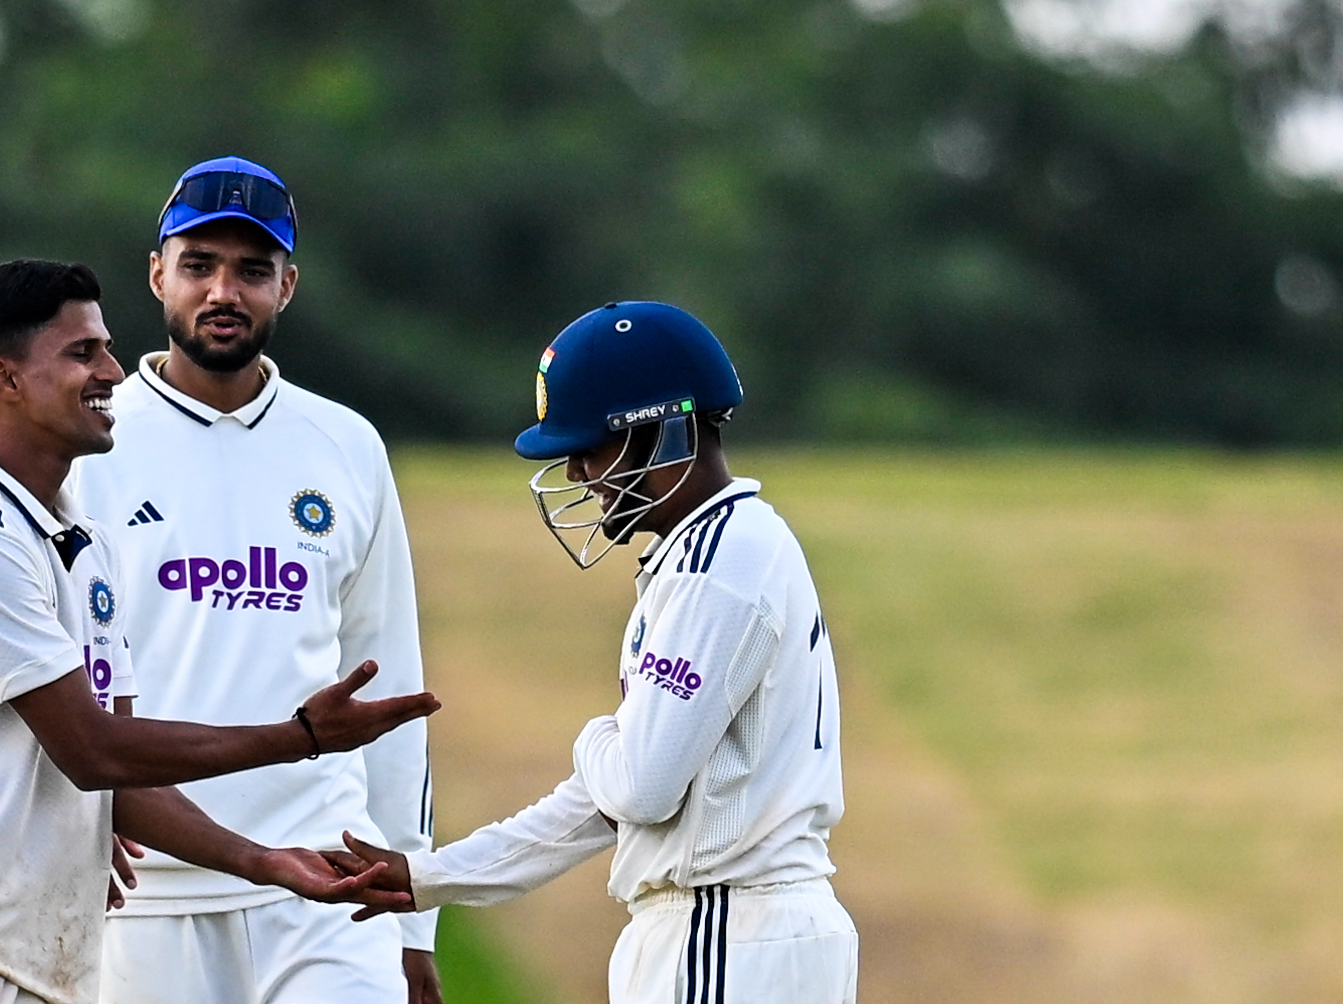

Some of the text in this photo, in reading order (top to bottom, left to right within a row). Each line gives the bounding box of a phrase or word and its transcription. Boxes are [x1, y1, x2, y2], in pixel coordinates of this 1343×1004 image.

[625, 404, 665, 423] SHREY
[158, 546, 308, 602] apollo
[211, 590, 303, 612] TYRES
[639, 652, 702, 690] pollo
[645, 671, 694, 701] TYRES
